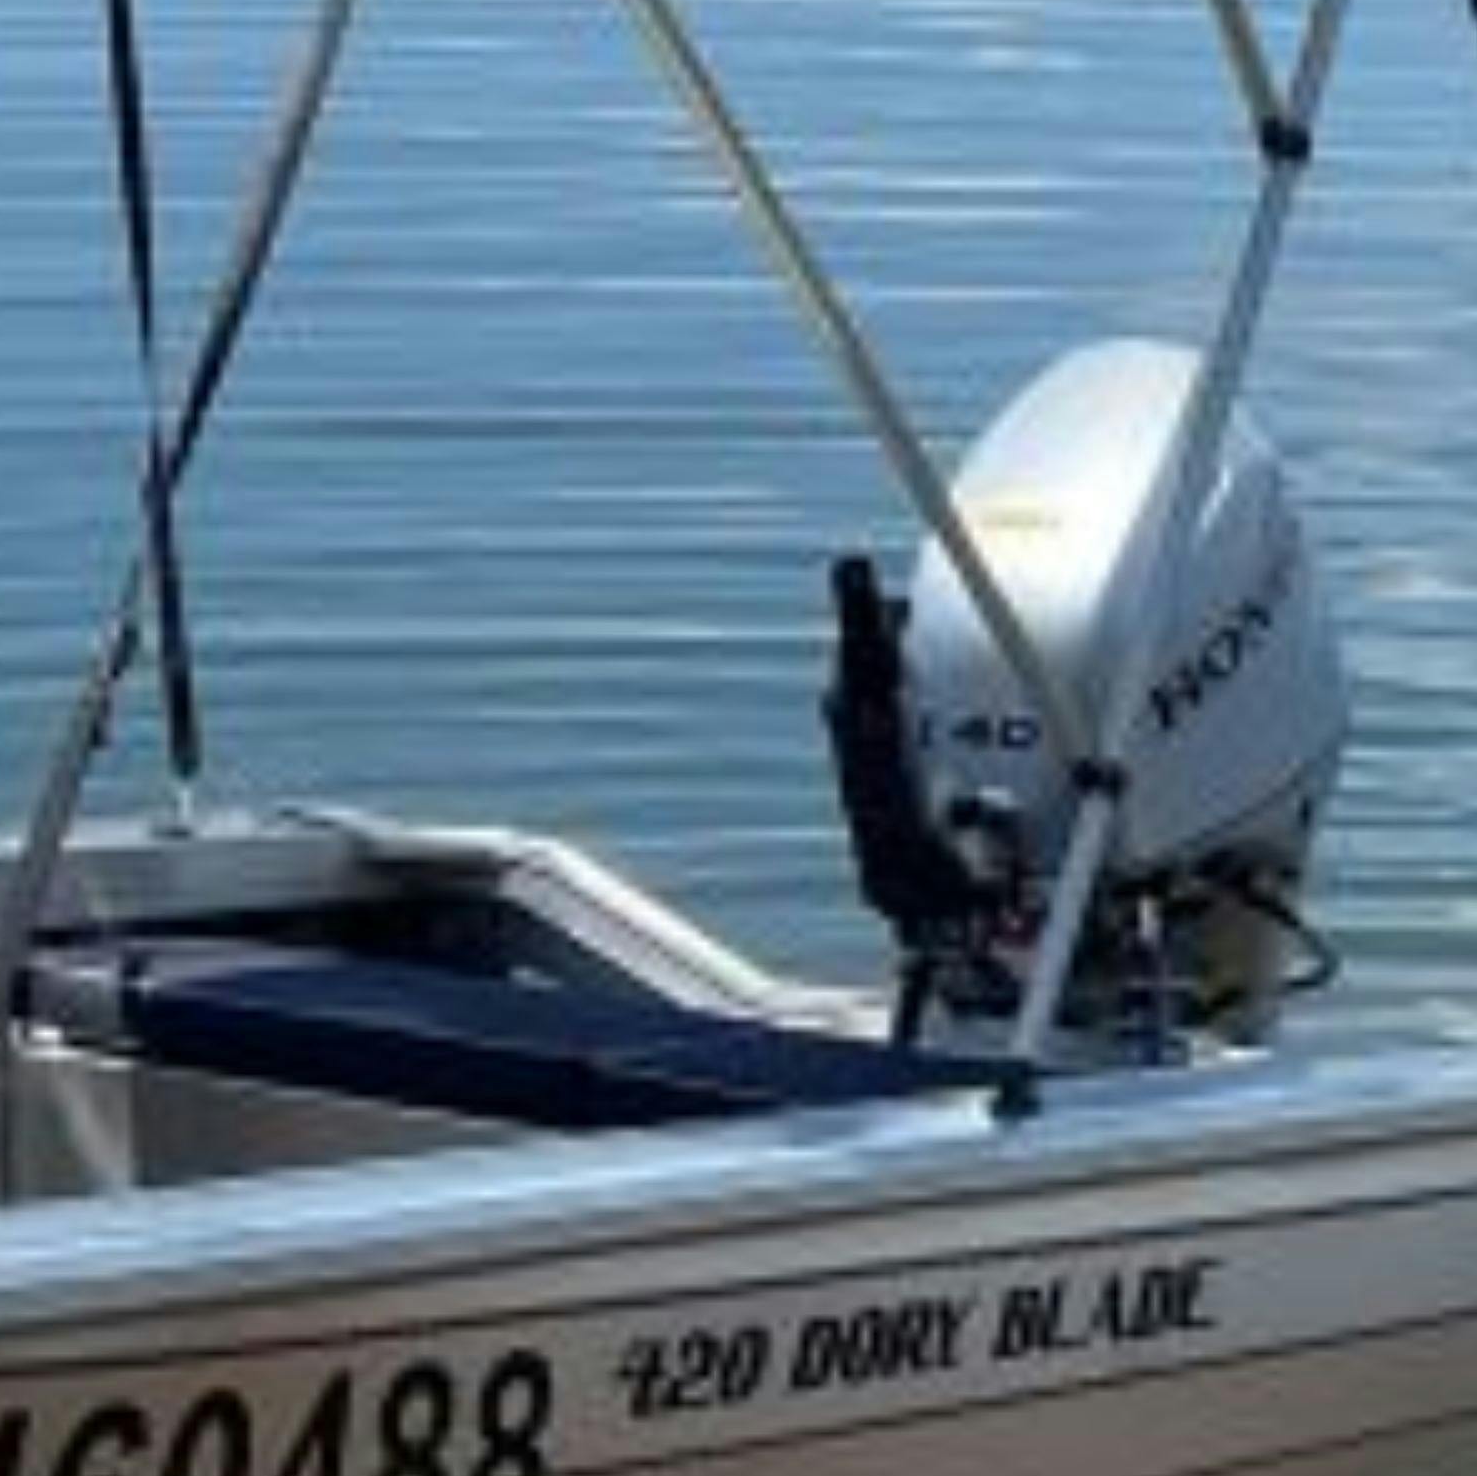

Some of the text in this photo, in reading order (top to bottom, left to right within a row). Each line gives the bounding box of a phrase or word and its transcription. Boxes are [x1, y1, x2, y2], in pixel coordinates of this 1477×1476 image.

[617, 1257, 1227, 1419] 420 DORY BLADE
